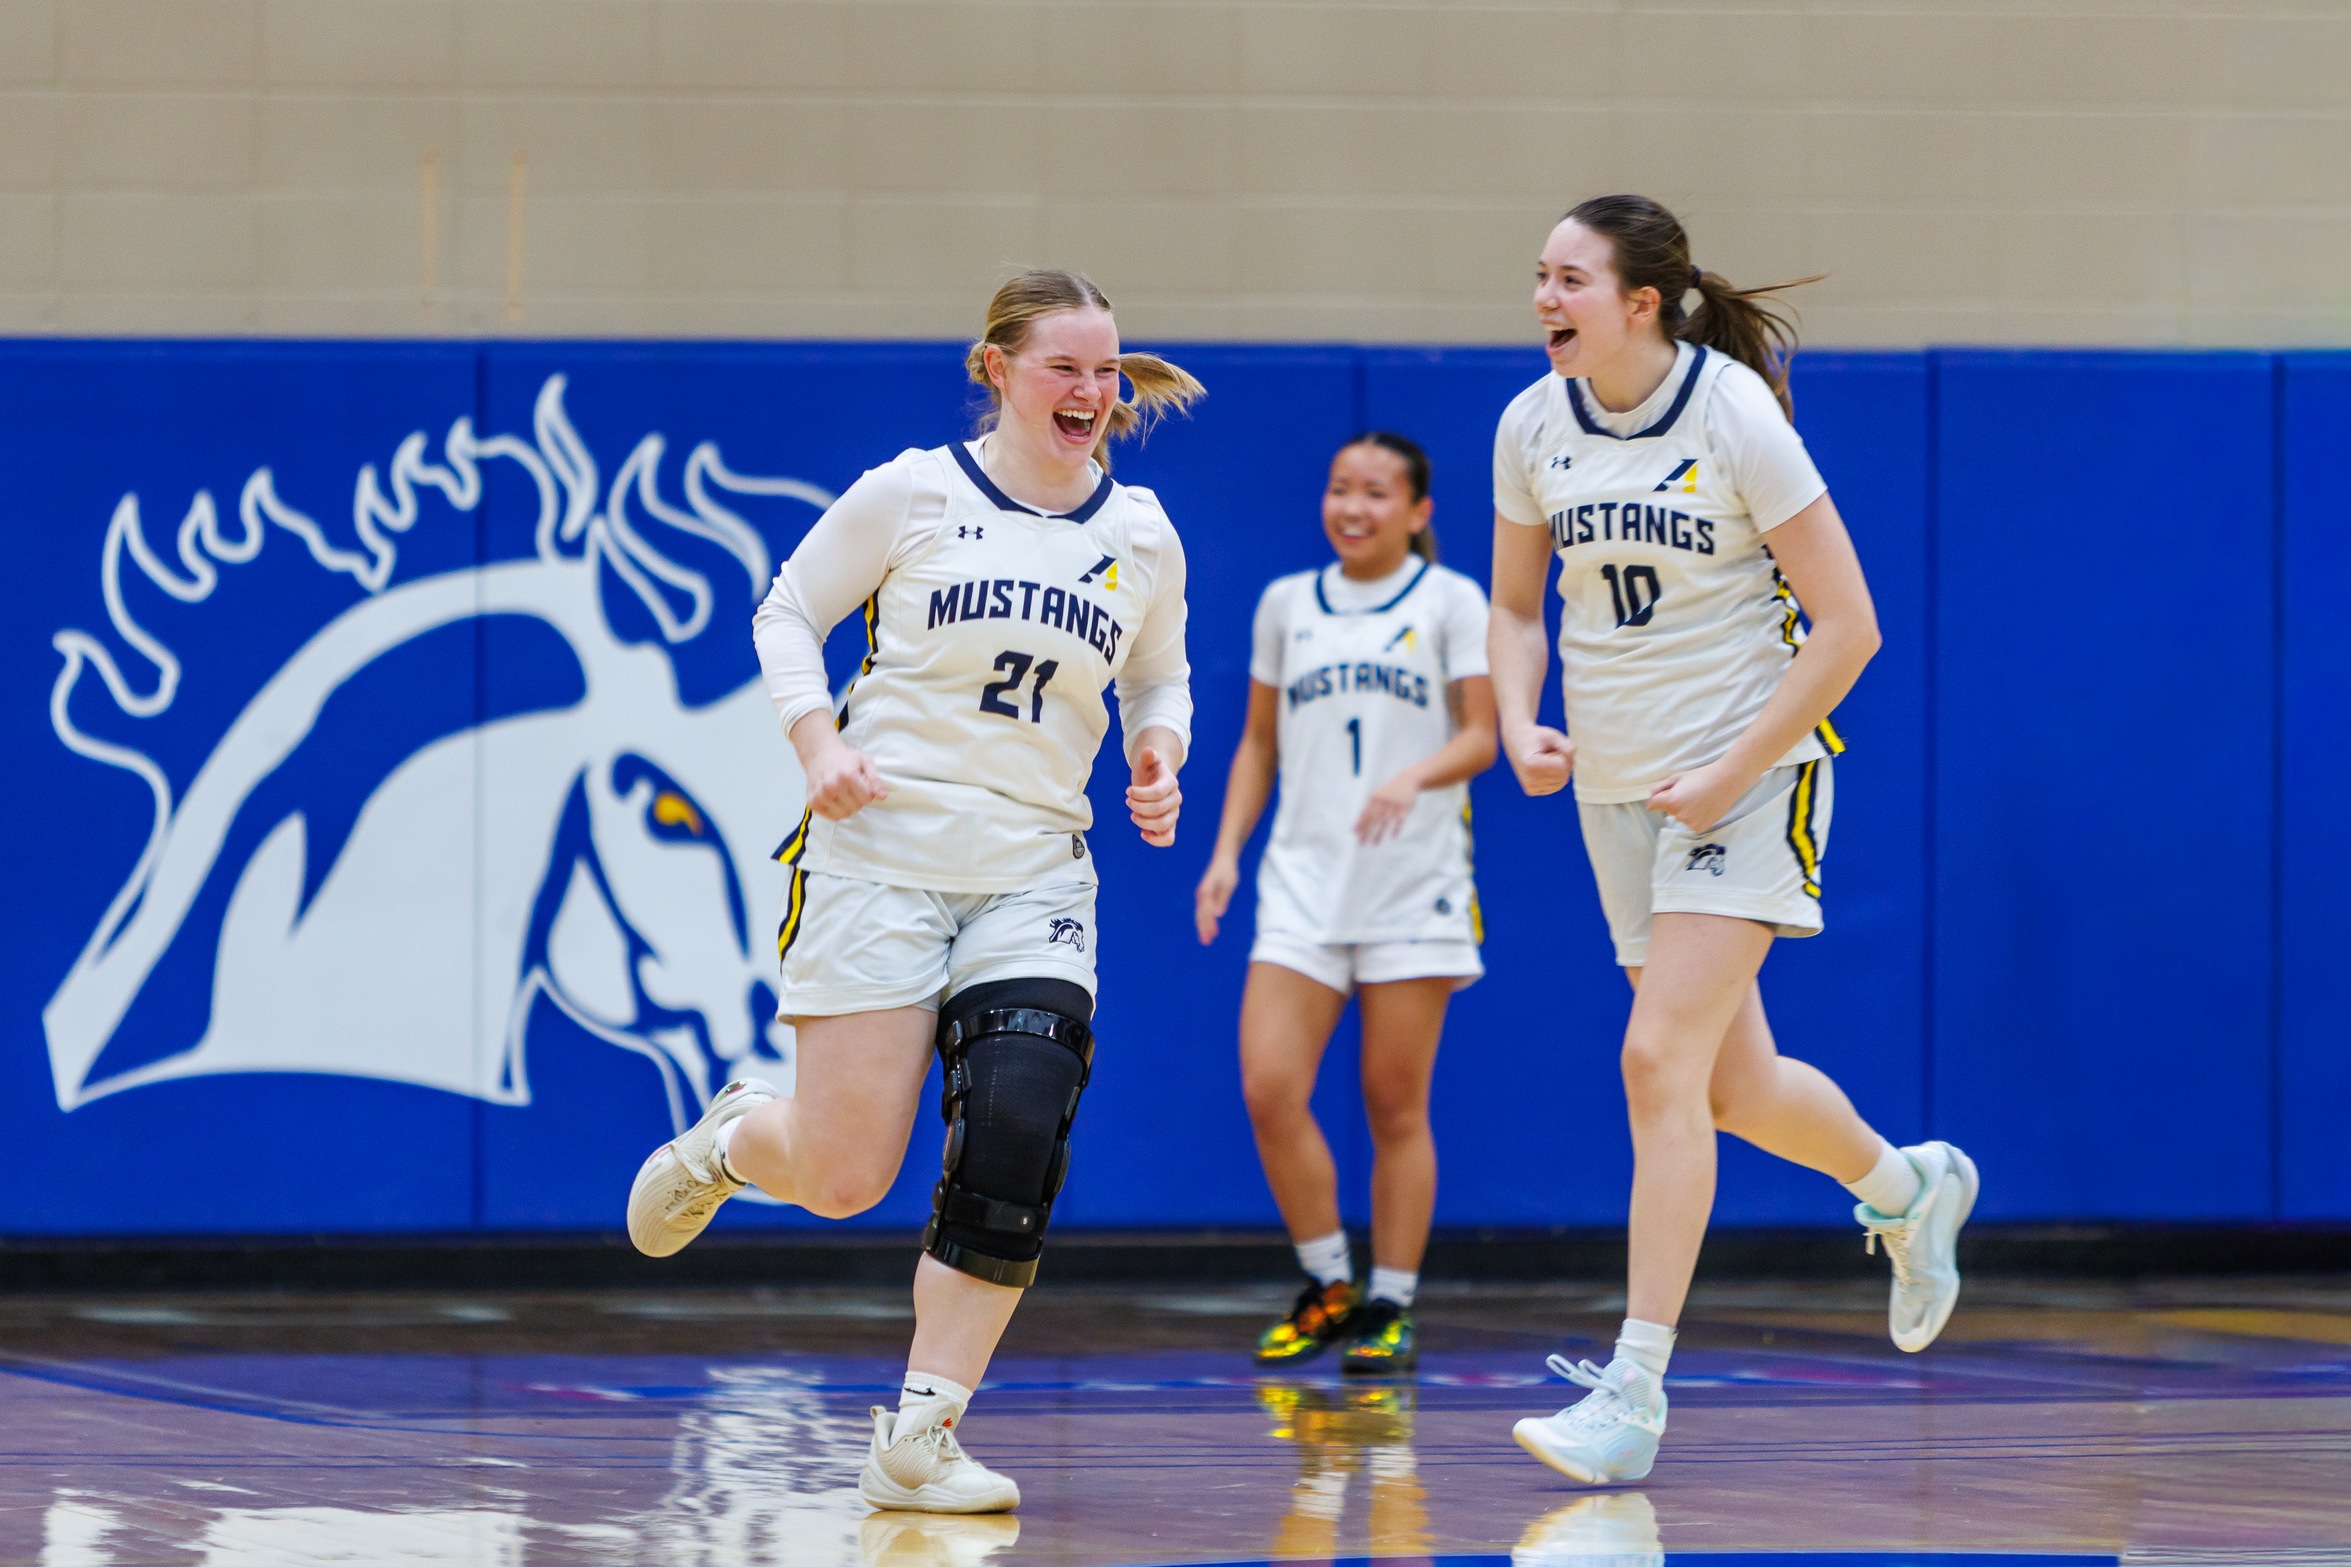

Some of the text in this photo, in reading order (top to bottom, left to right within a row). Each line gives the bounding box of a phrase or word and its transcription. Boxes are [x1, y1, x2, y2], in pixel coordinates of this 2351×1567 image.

[927, 579, 1123, 667] MUSTANGS
[1600, 563, 1662, 630] 10
[979, 650, 1059, 724] 21
[1346, 718, 1360, 778] 1
